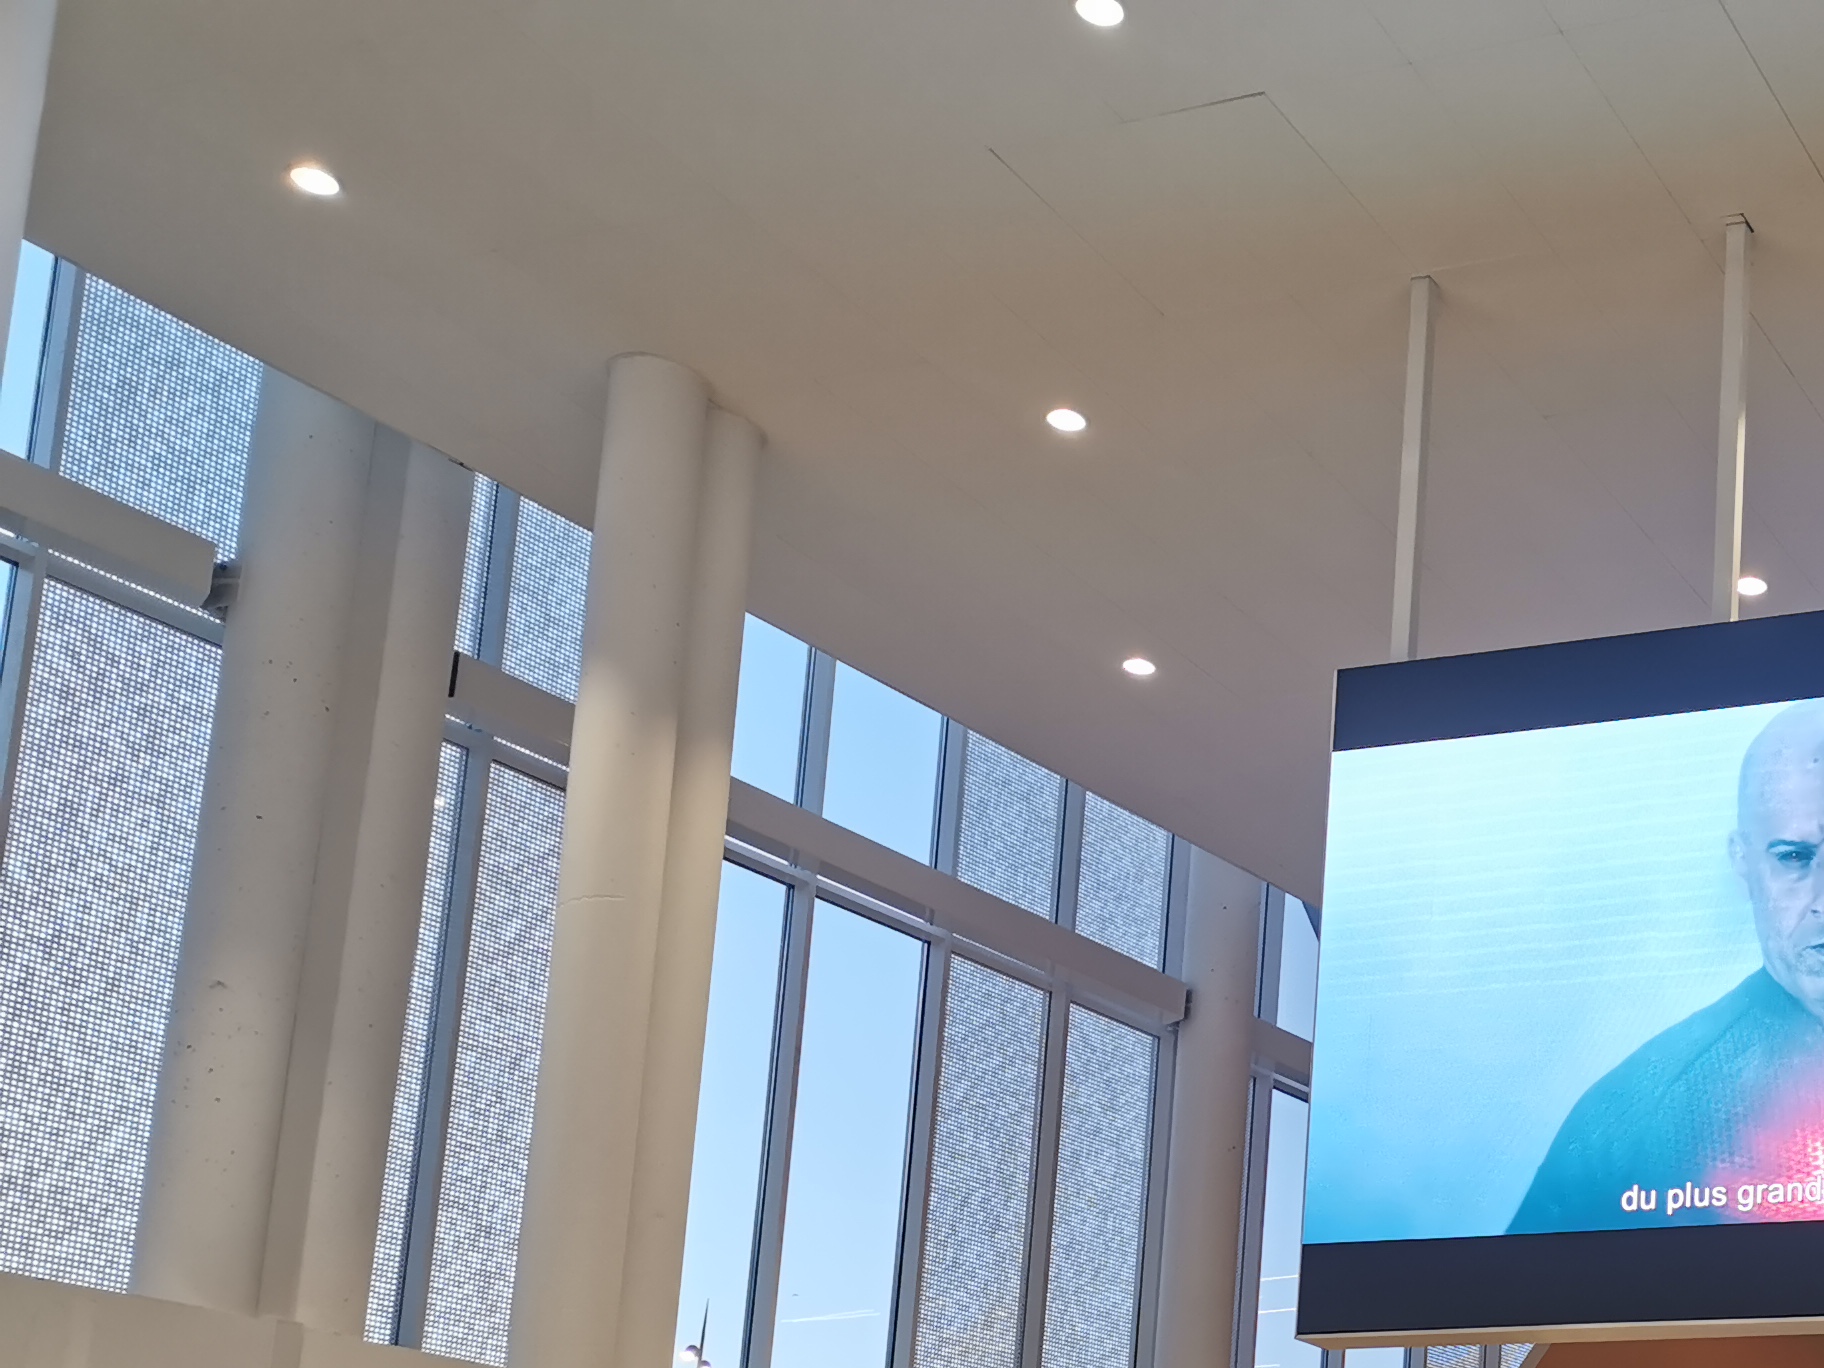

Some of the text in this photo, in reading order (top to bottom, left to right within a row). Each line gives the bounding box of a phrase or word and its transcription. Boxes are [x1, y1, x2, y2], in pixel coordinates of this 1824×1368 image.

[1620, 1184, 1656, 1211] du
[1666, 1182, 1728, 1216] plus
[1736, 1175, 1823, 1212] grand
